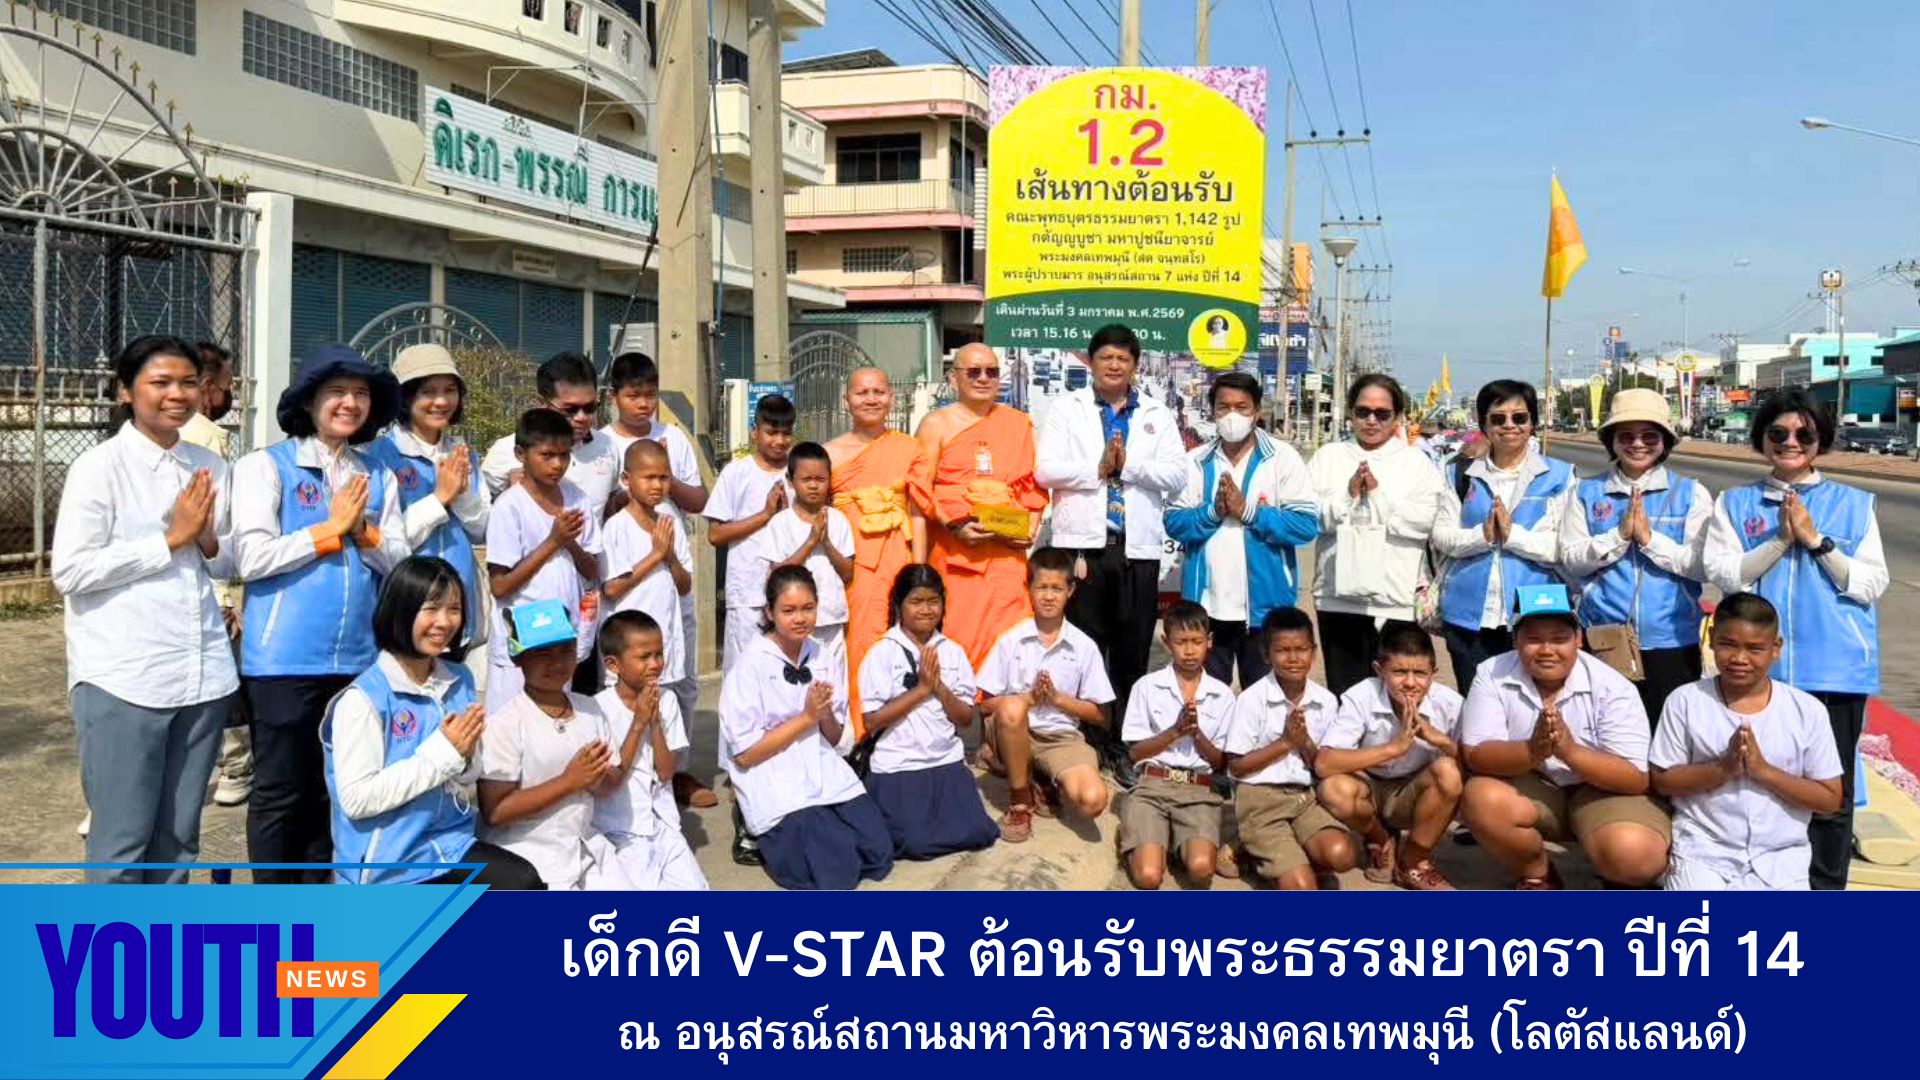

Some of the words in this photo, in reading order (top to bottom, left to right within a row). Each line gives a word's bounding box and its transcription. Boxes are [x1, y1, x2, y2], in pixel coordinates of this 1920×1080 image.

[1094, 84, 1156, 110] กม.
[1079, 118, 1164, 166] 1.2
[1016, 169, 1233, 203] เส้นทางต้อนรับ
[603, 173, 658, 222] การแ
[1223, 213, 1241, 231] รูป
[1039, 251, 1130, 267] พระมงคลเทพมุนี
[1003, 267, 1083, 284] พระผู้ปราบมาร
[1165, 270, 1173, 282] 7
[1176, 270, 1199, 283] แห่ง
[1202, 267, 1220, 283] ปีที่
[1224, 270, 1241, 283] 14
[995, 301, 1064, 317] เดินผ่านวันที่
[1067, 306, 1076, 317] 3
[1079, 307, 1124, 318] มกราคม
[1127, 307, 1185, 319] พ.ศ.2569
[1010, 327, 1039, 338] เวลา
[1042, 326, 1078, 339] 15.16
[1152, 330, 1167, 341] น.
